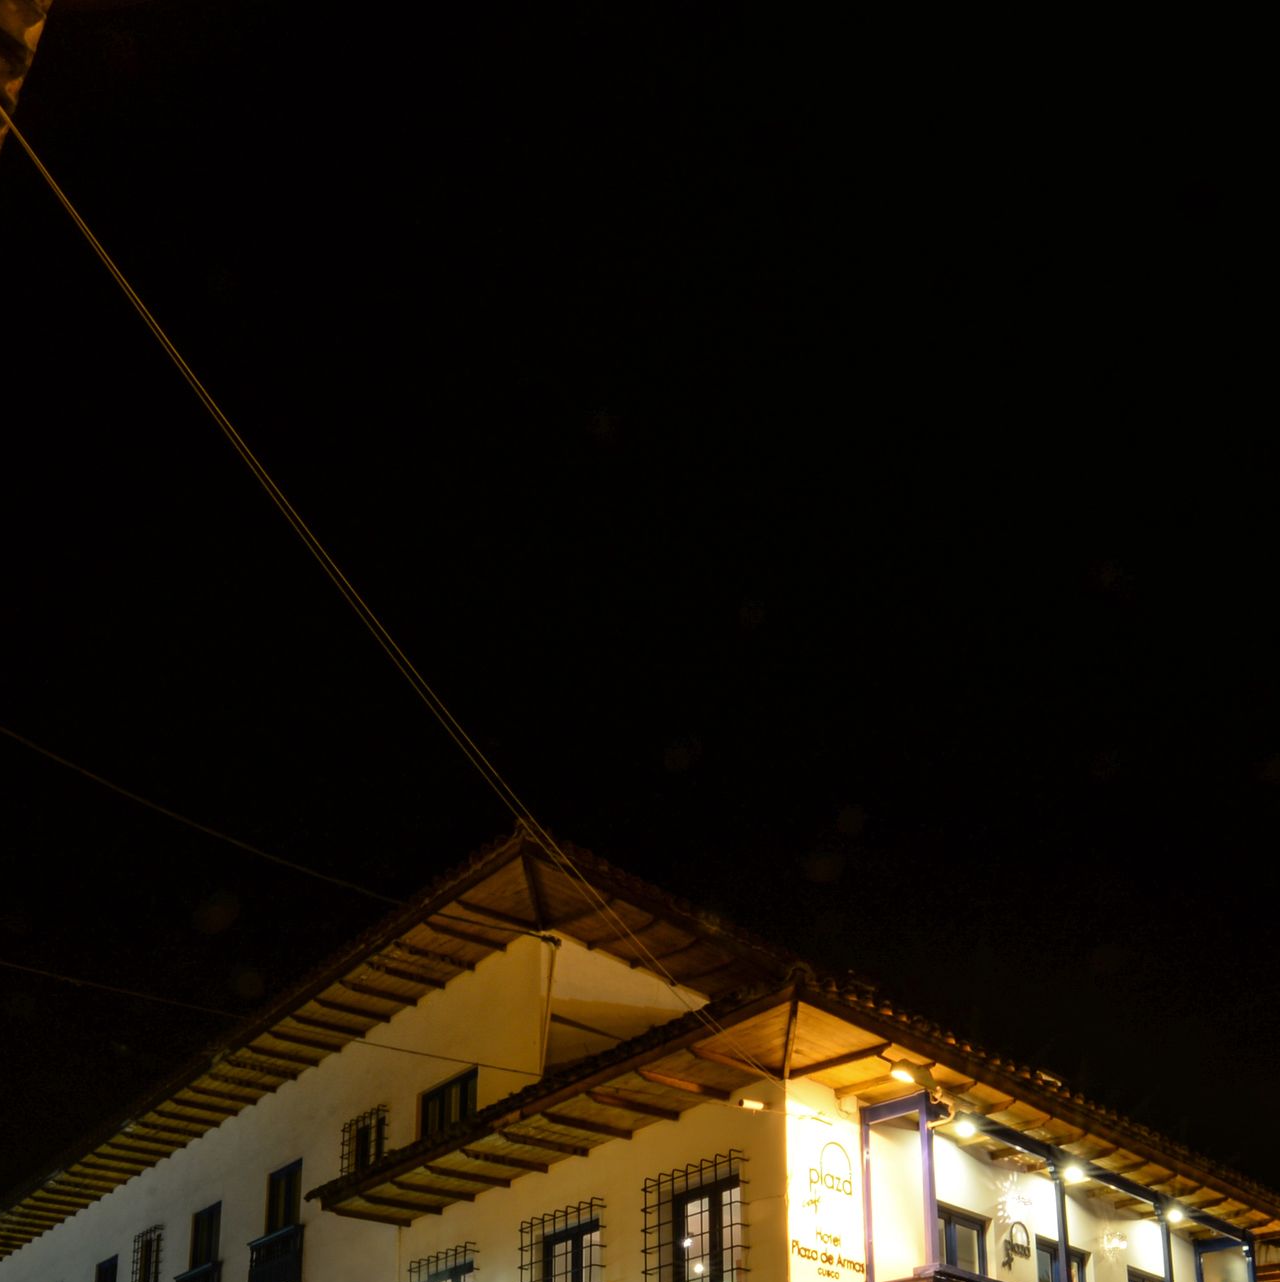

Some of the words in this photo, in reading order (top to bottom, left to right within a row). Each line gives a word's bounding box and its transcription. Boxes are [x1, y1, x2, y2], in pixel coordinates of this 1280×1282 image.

[816, 1226, 841, 1248] Hotel
[791, 1240, 818, 1261] Plaza
[821, 1247, 834, 1265] de
[836, 1253, 864, 1274] Armas
